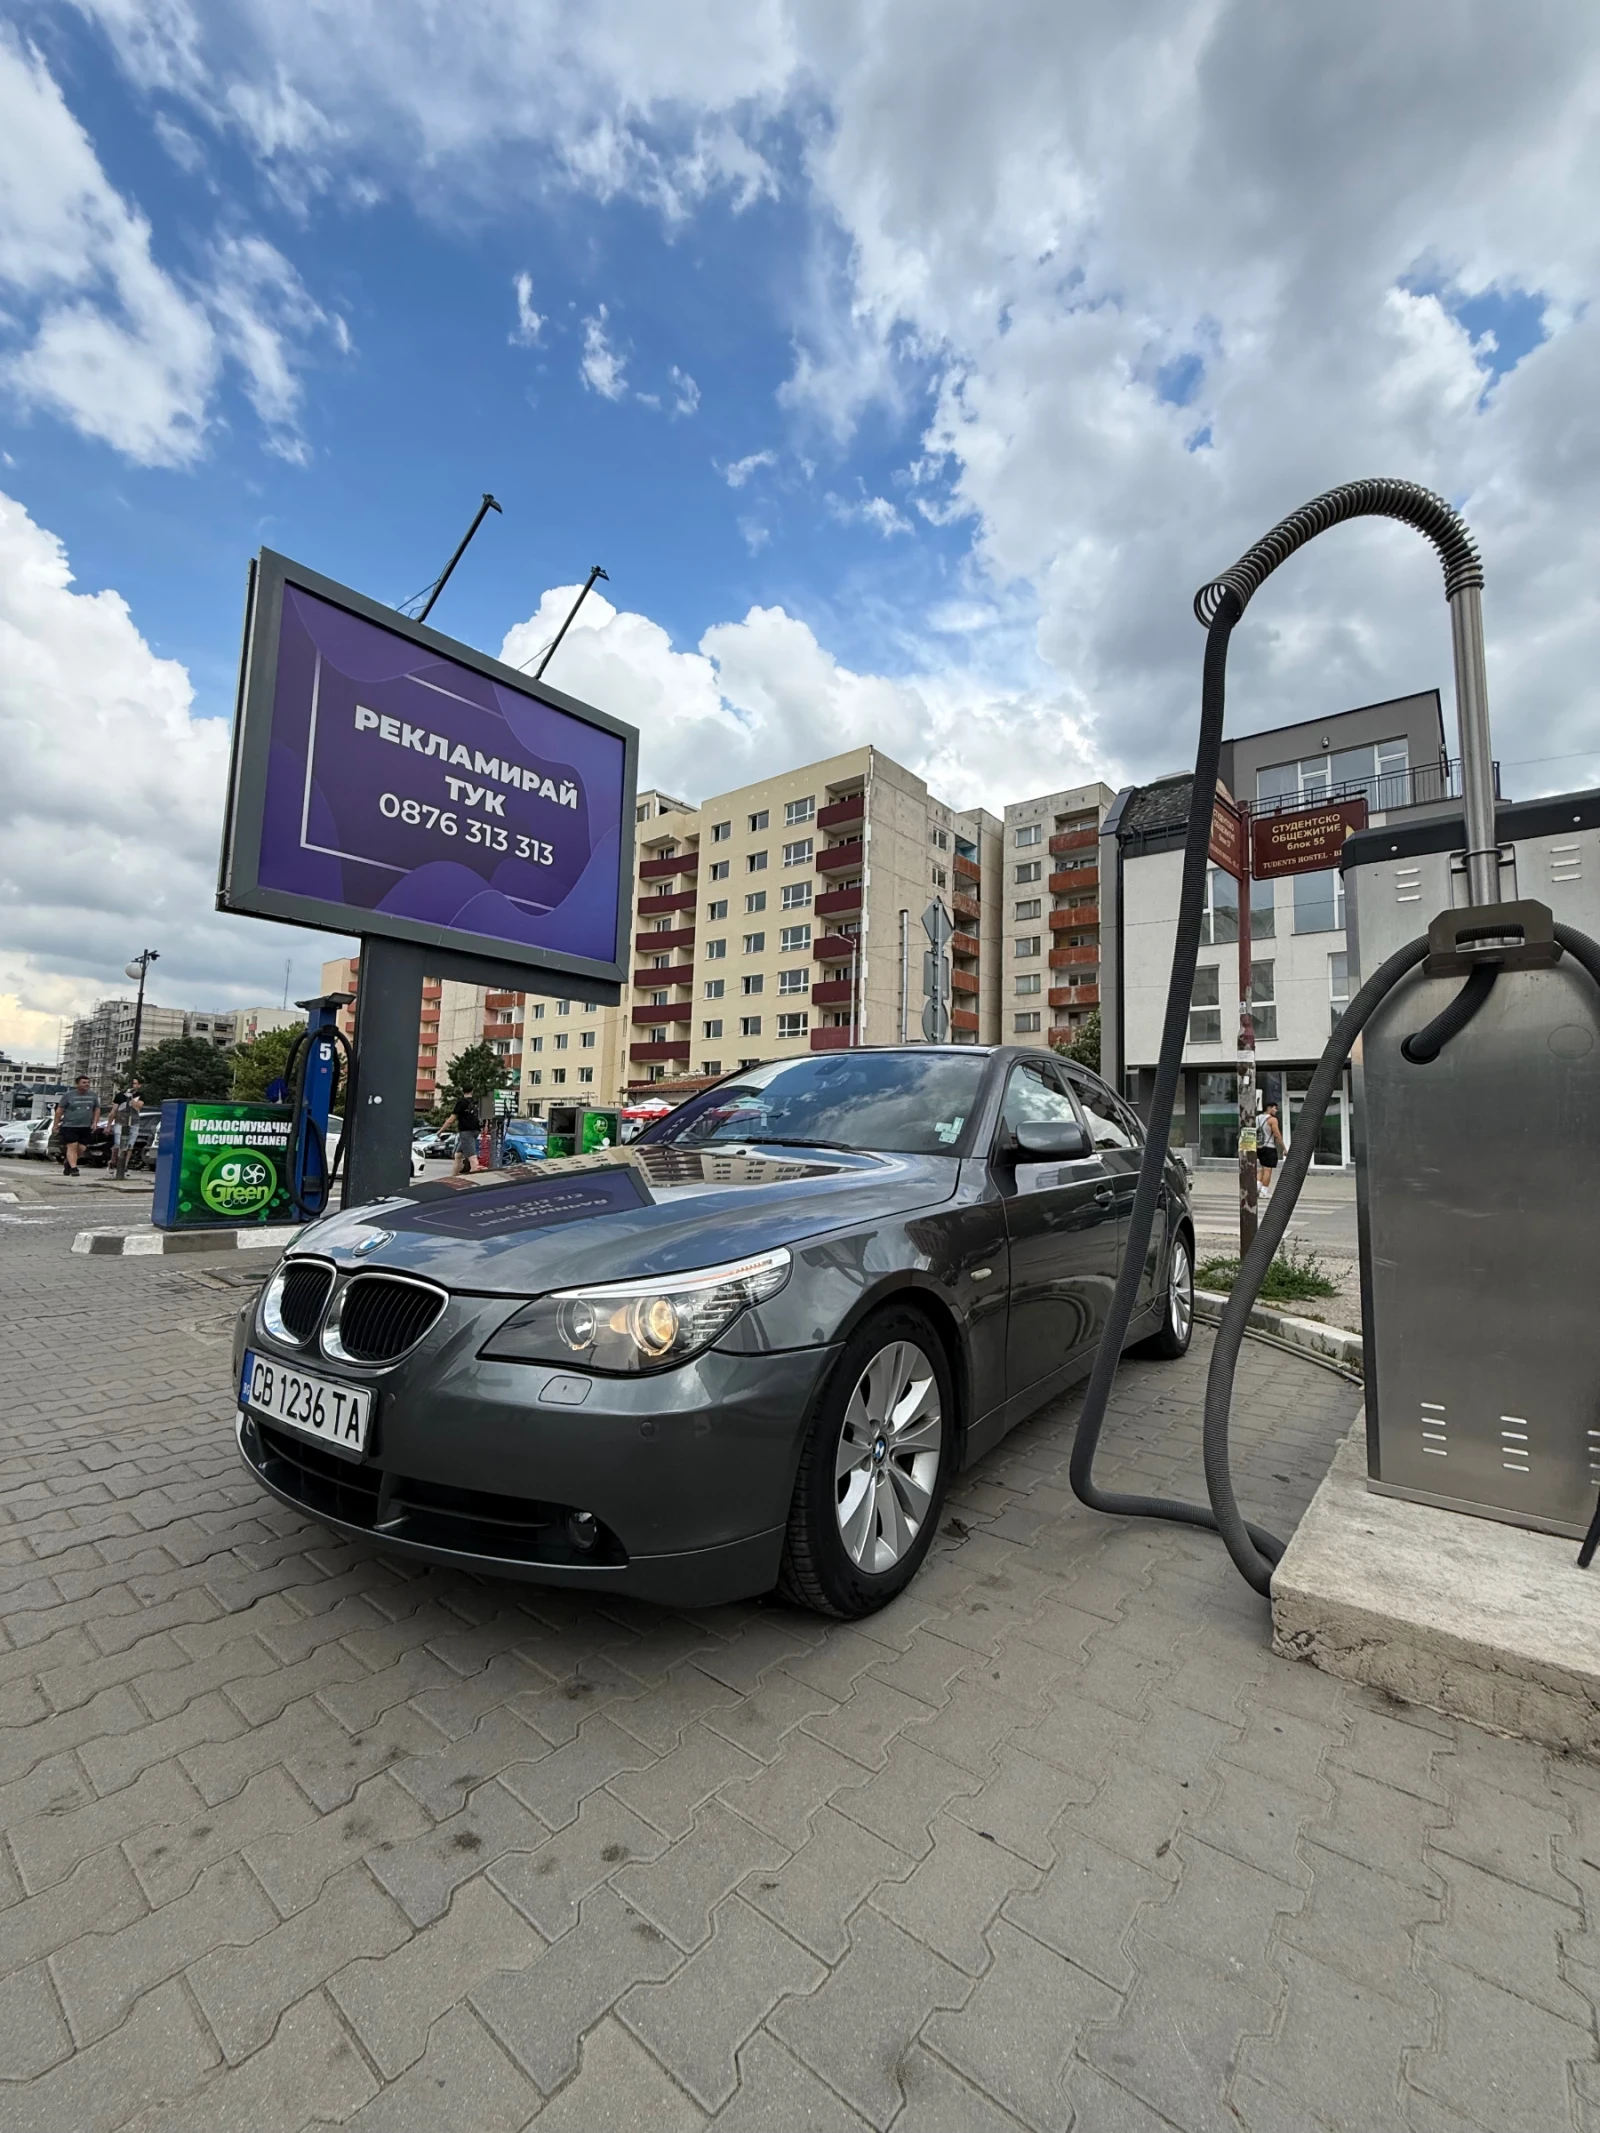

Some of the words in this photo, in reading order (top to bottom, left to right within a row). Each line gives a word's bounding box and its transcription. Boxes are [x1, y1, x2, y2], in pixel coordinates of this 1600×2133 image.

[354, 704, 579, 810] РЕКЛАМИРАЙ
[445, 775, 507, 817] ТУК
[379, 793, 459, 838] 0876
[465, 818, 509, 851] 313
[515, 834, 554, 866] 313
[1271, 823, 1341, 843] ОБЩЕЖИТИЕ
[1272, 813, 1340, 833] СТУДЕНТСКО
[1287, 841, 1311, 851] блок
[1313, 836, 1325, 846] 55
[320, 1042, 331, 1061] 5
[197, 1133, 243, 1145] VACUUM
[245, 1134, 288, 1146] CLEANER
[206, 1179, 269, 1203] Green
[252, 1363, 274, 1407] CB
[279, 1374, 325, 1428] 1236
[332, 1390, 360, 1443] TA
